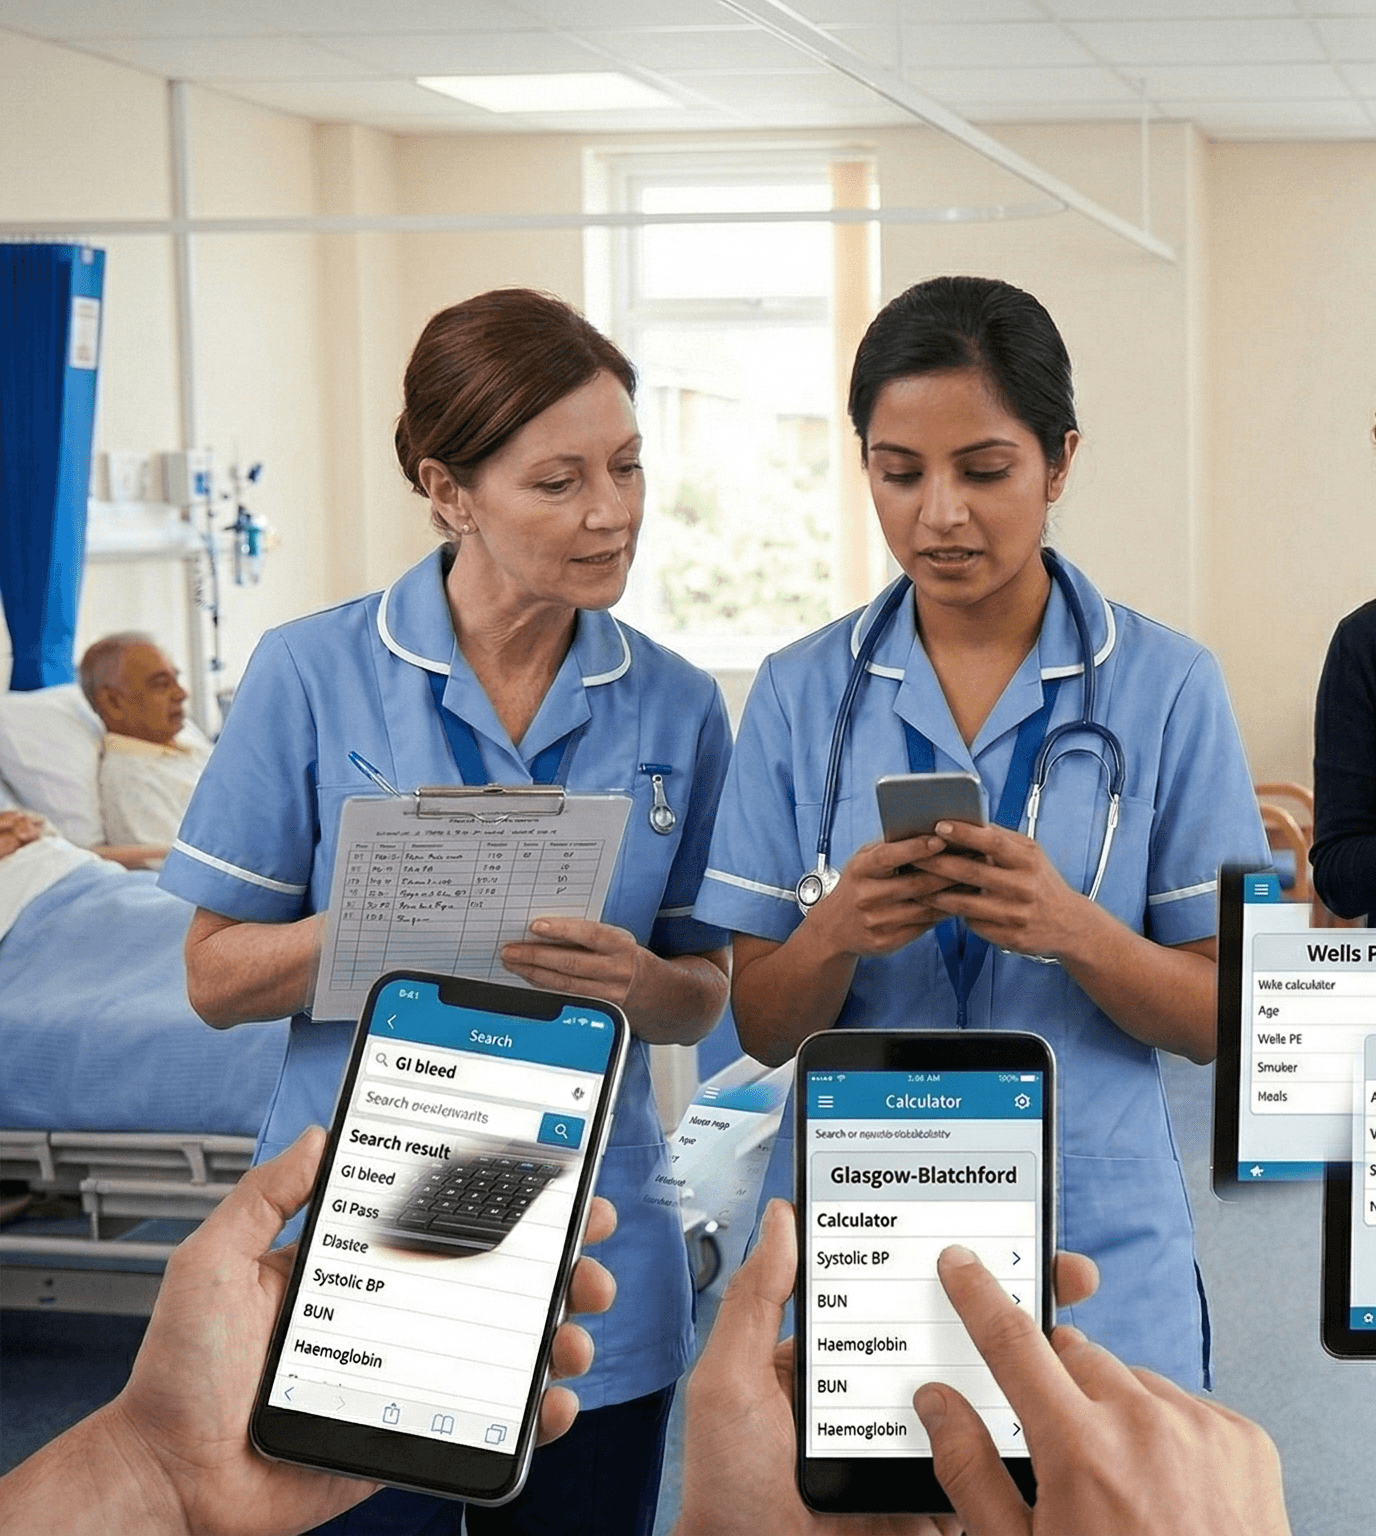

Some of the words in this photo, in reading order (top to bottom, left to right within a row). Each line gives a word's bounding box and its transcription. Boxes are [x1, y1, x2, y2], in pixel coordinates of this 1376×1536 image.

[1307, 944, 1361, 963] Wells
[1258, 1005, 1280, 1019] Age
[469, 1029, 513, 1048] Search
[1289, 1033, 1302, 1044] PE
[396, 1057, 412, 1072] GI
[414, 1058, 457, 1079] bleed
[365, 1091, 409, 1109] Search
[886, 1094, 962, 1109] Calculator
[815, 1129, 846, 1139] Search
[848, 1131, 857, 1139] or
[349, 1128, 401, 1151] Search
[405, 1138, 451, 1160] result
[341, 1165, 357, 1179] GI
[358, 1165, 396, 1185] bleed
[830, 1166, 1017, 1189] Glasgow-Blatchford
[332, 1199, 347, 1214] GI
[349, 1203, 379, 1218] Pass
[817, 1213, 897, 1228] Calculator
[817, 1251, 867, 1269] Systolic
[872, 1251, 889, 1265] BP
[313, 1268, 363, 1290] Systolic
[366, 1278, 385, 1293] BP
[817, 1294, 848, 1308] BUN
[303, 1304, 334, 1321] BUN
[294, 1339, 383, 1368] Haemoglobin
[817, 1337, 907, 1355] Haemoglobin
[817, 1379, 848, 1393] BUN
[817, 1422, 907, 1440] Haemoglobin
